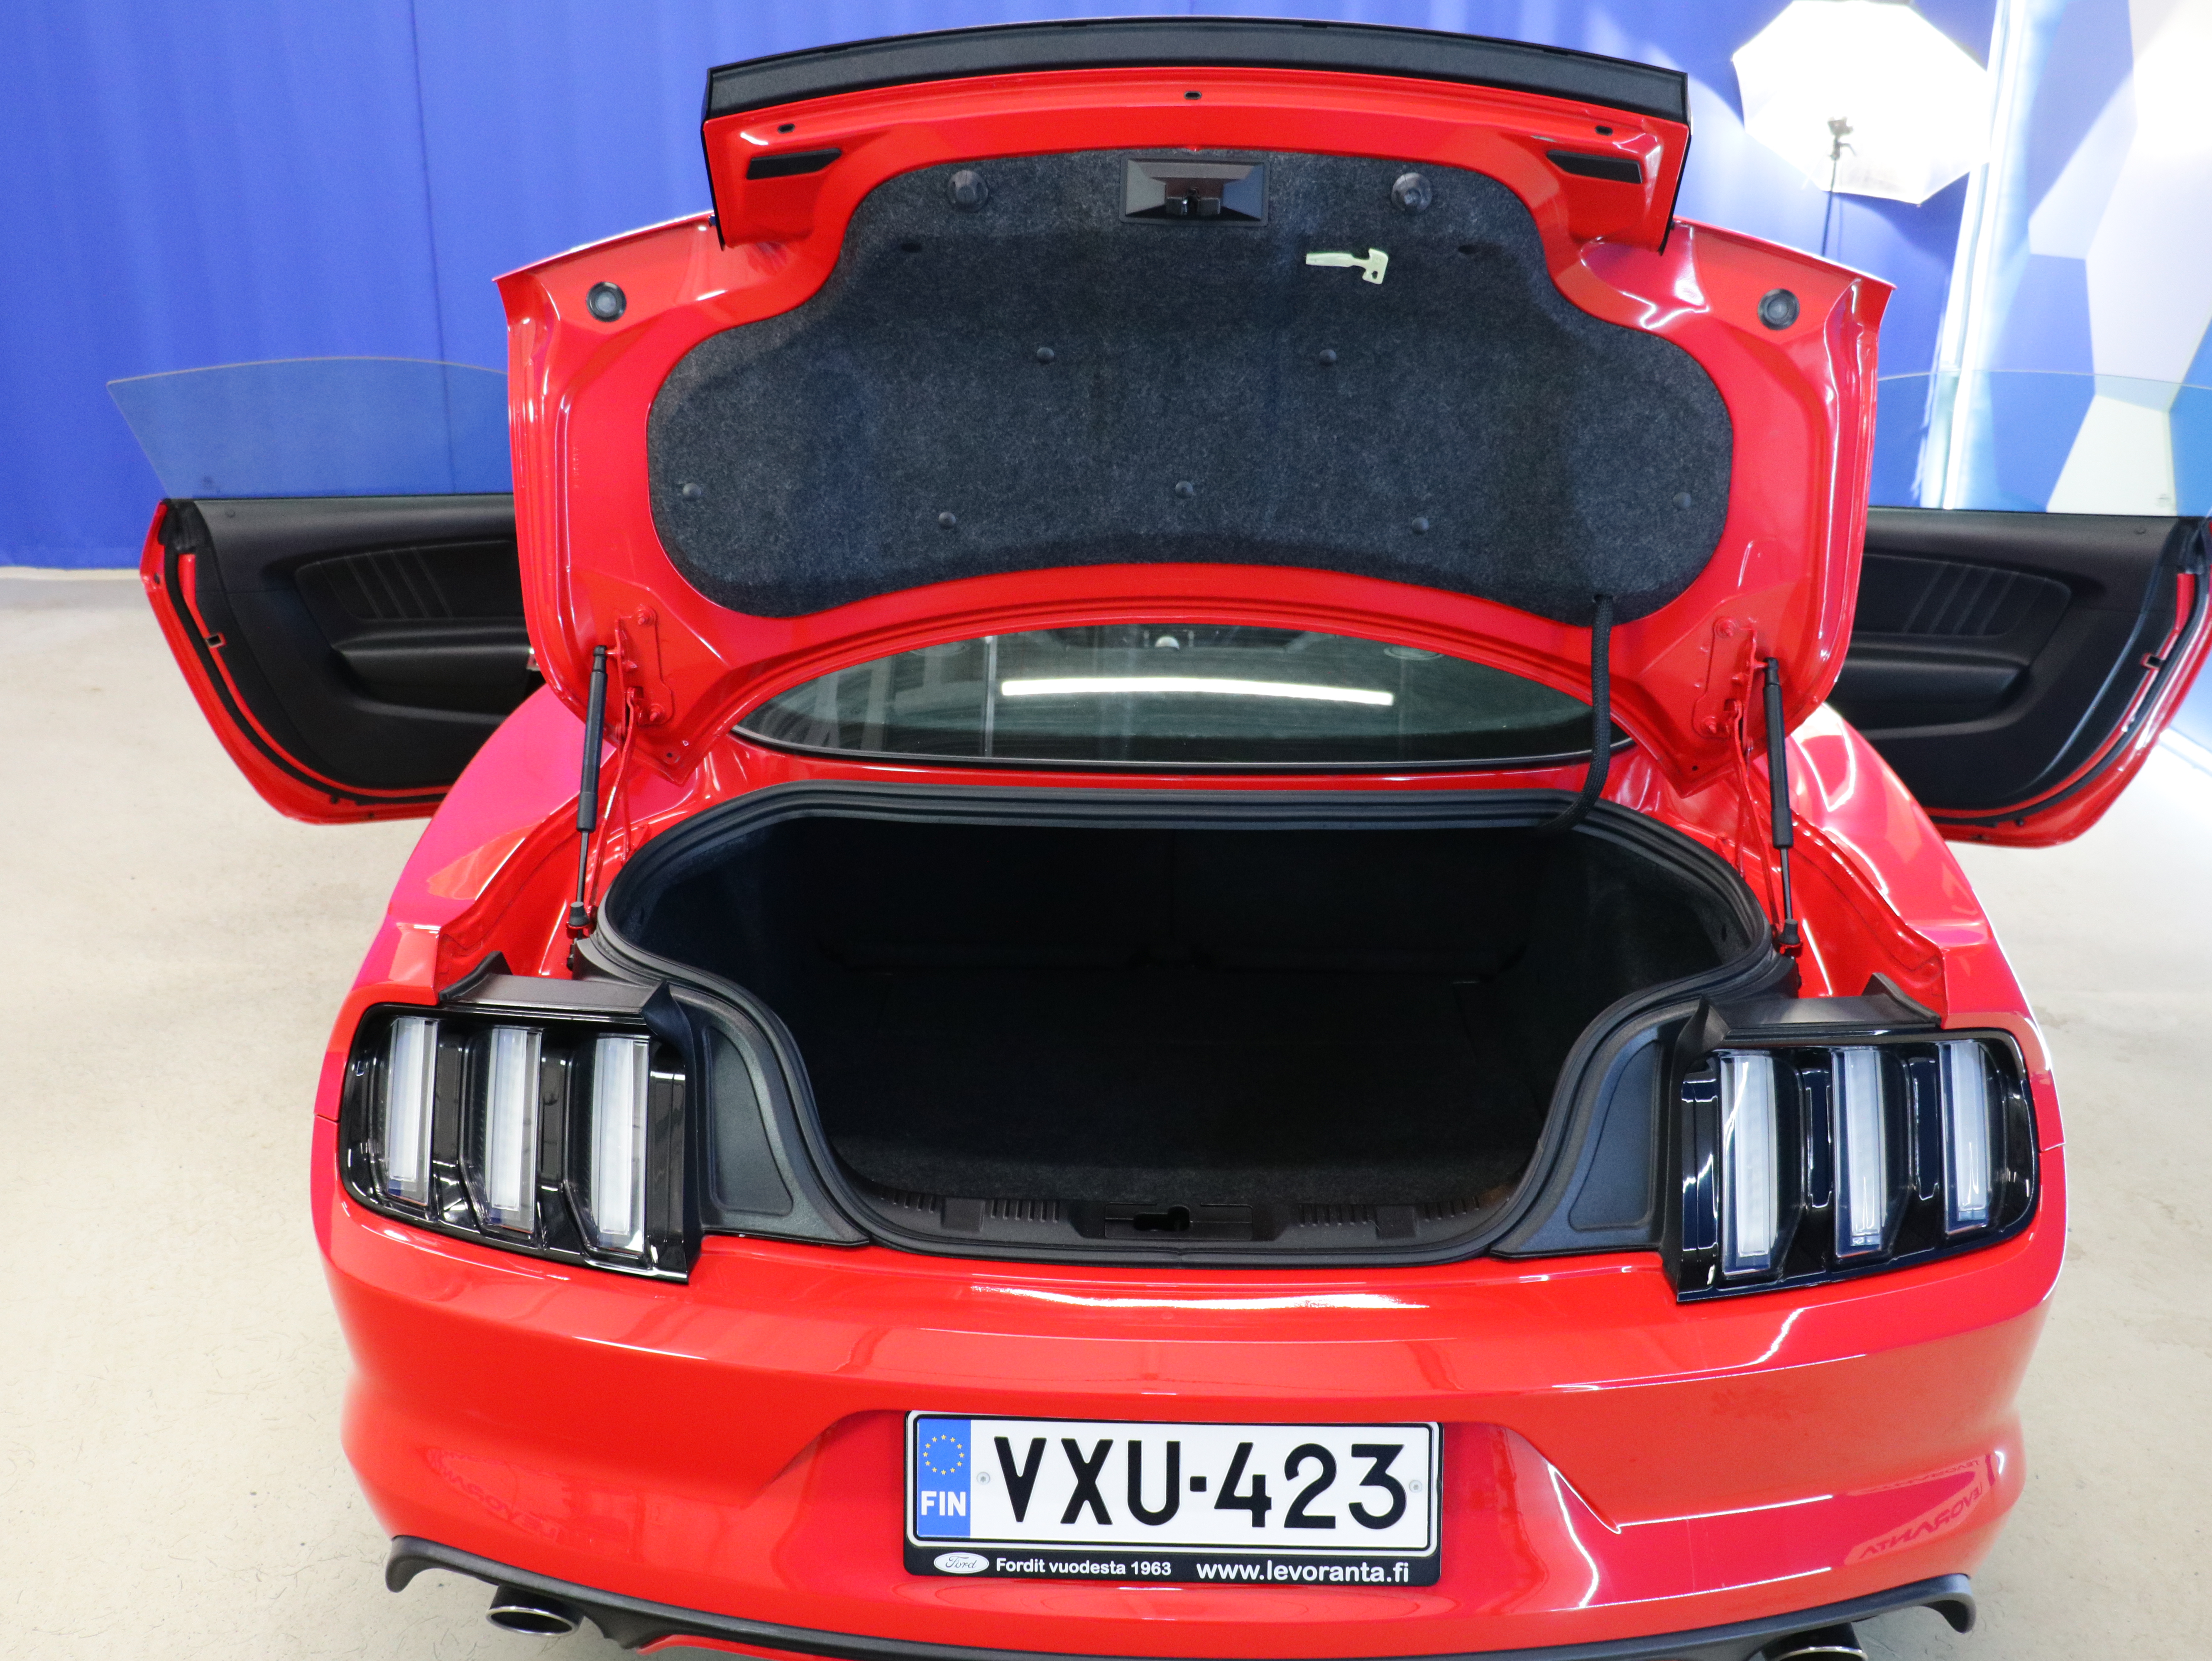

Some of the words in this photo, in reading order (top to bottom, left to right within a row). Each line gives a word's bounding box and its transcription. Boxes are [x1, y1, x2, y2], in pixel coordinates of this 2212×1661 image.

[994, 1436, 1406, 1530] VXU-423
[920, 1490, 967, 1517] FIN
[996, 1557, 1046, 1573] Fordit
[1048, 1559, 1126, 1575] vuodesta
[1130, 1561, 1172, 1576] 1963
[1196, 1559, 1409, 1583] www.levoranta.fi
